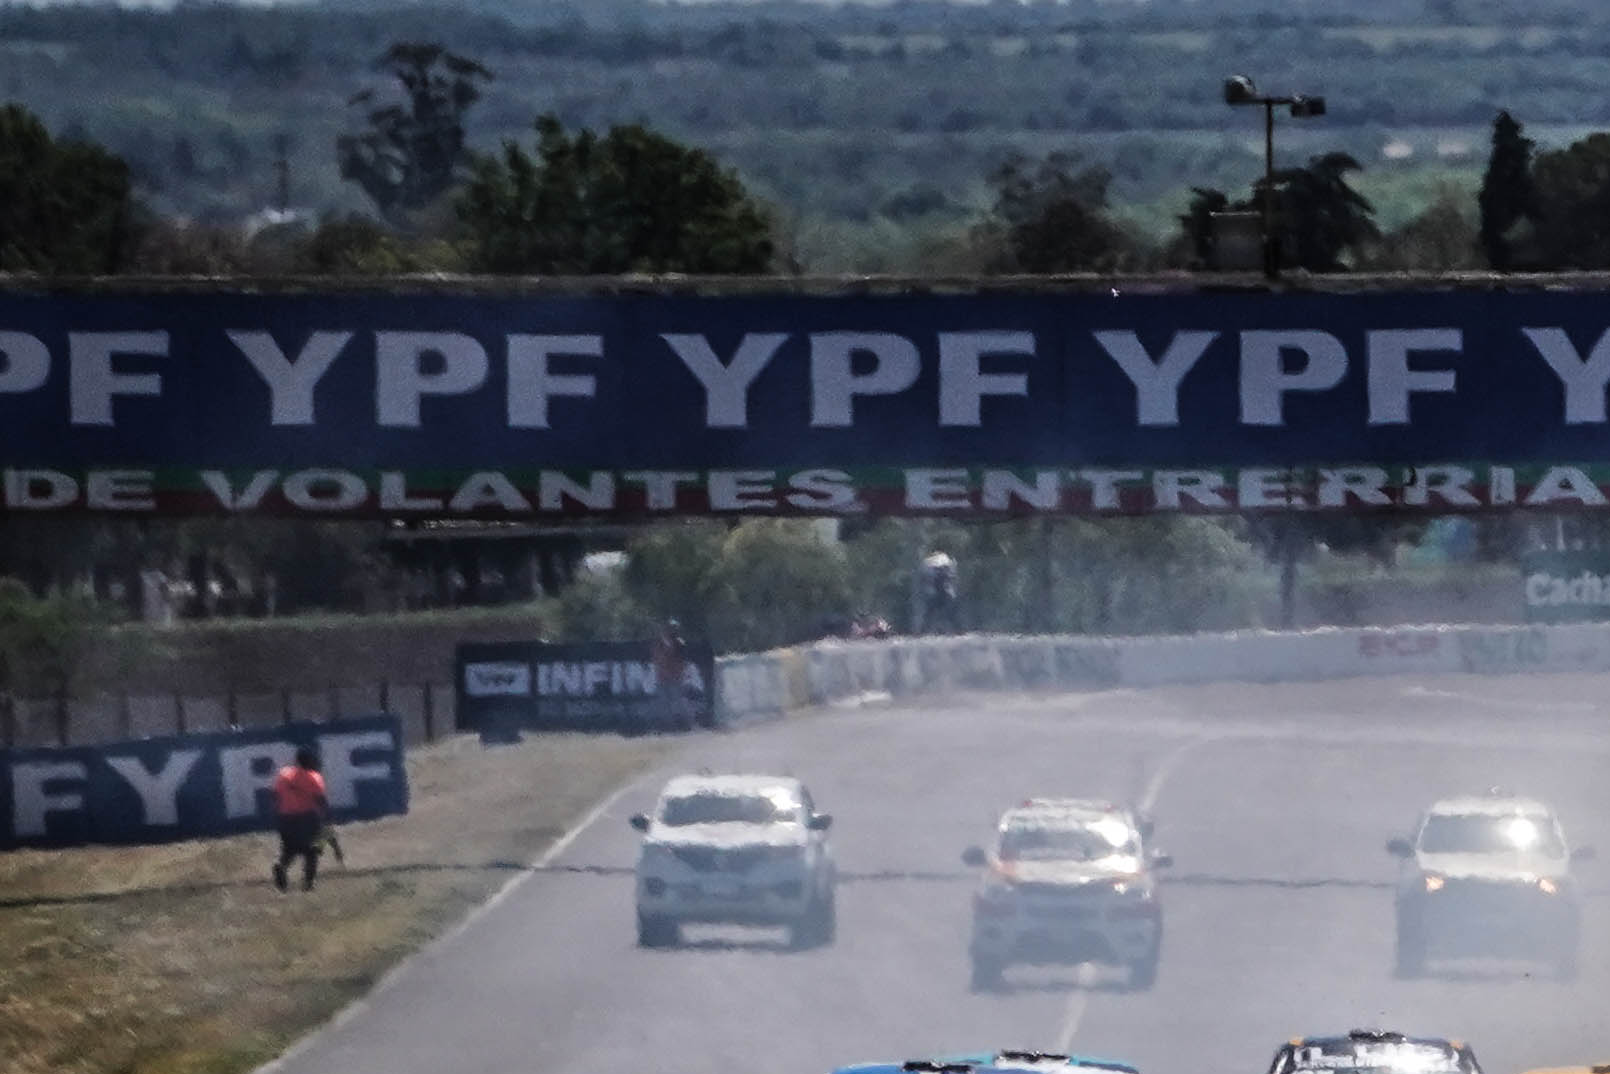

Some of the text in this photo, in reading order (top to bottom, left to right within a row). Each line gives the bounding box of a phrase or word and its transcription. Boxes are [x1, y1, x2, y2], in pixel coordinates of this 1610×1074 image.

[225, 331, 603, 428] YPF
[659, 331, 1035, 428] YPF
[1092, 329, 1463, 426] YPF
[3, 470, 156, 511] DE
[200, 469, 861, 514] VOLANTES
[106, 731, 395, 826] YPF
